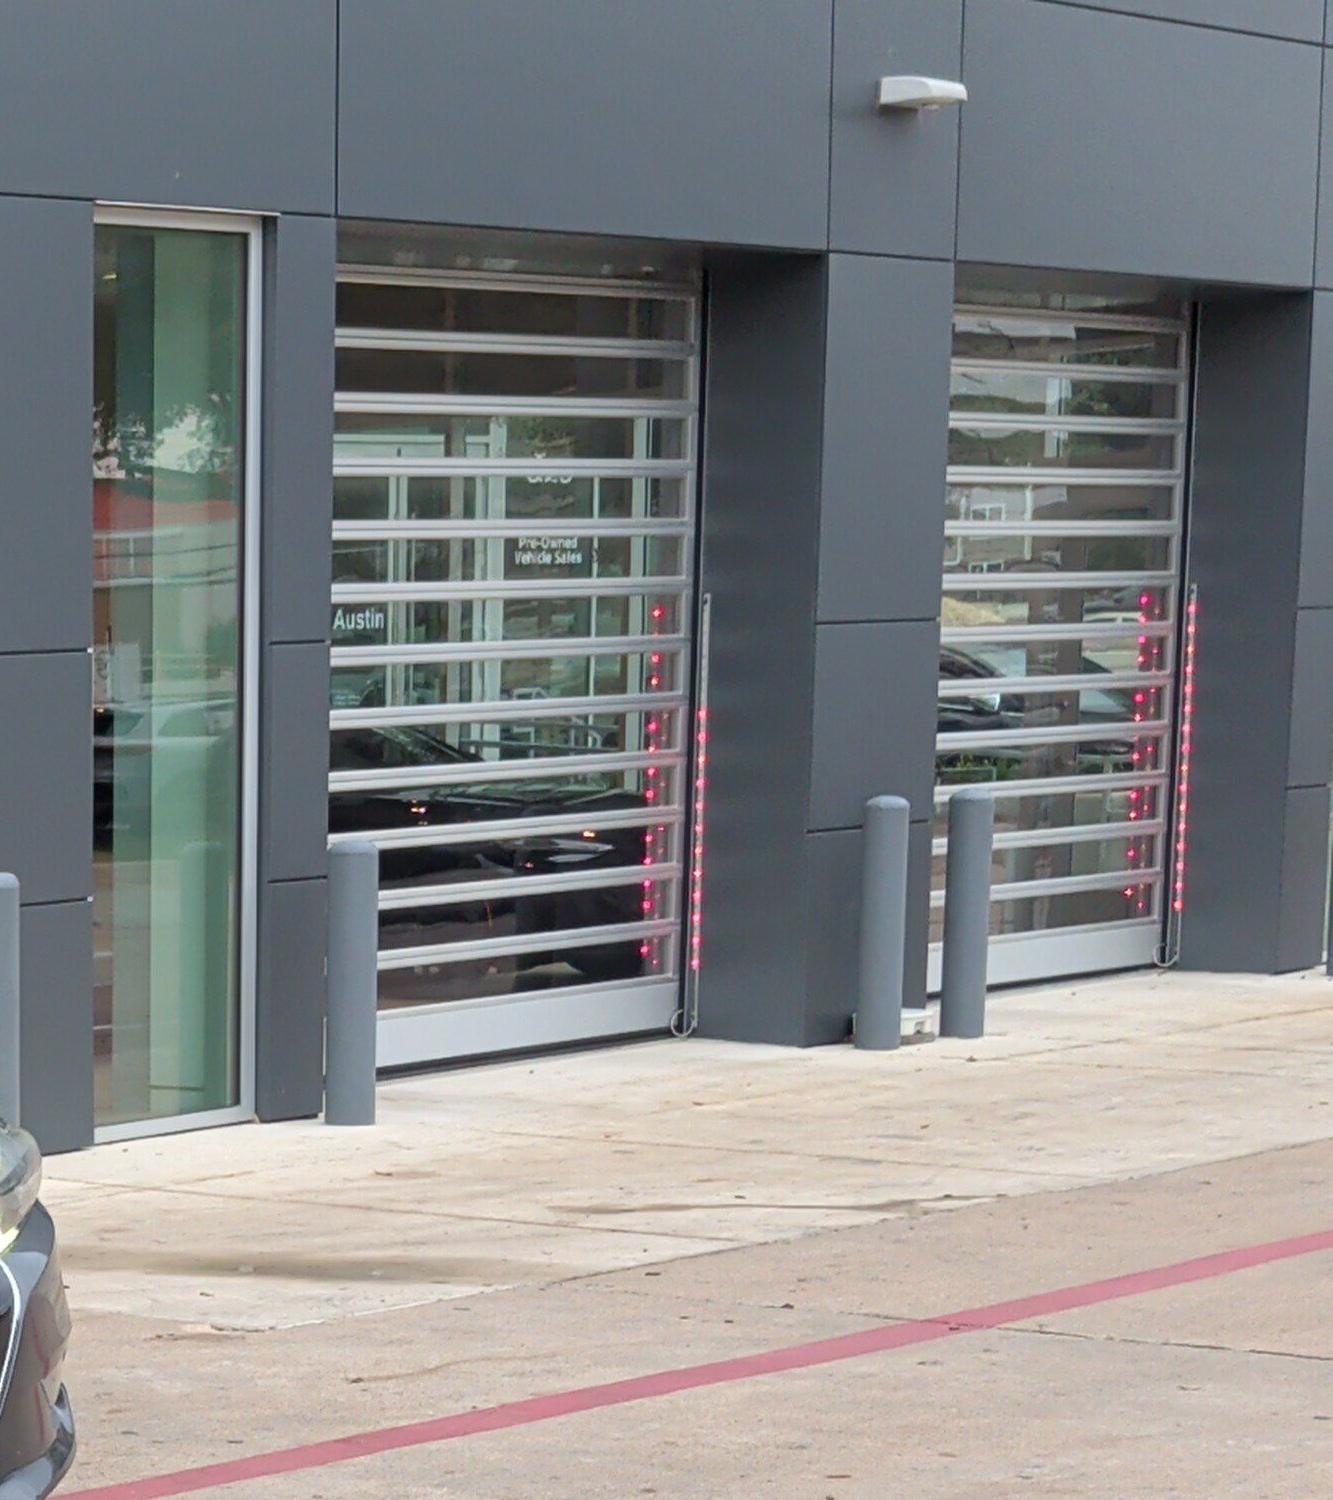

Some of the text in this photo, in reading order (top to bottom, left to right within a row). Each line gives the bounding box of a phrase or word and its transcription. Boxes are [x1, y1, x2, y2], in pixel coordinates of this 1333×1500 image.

[514, 551, 583, 565] Vehicle Sales
[333, 608, 385, 630] Austin
